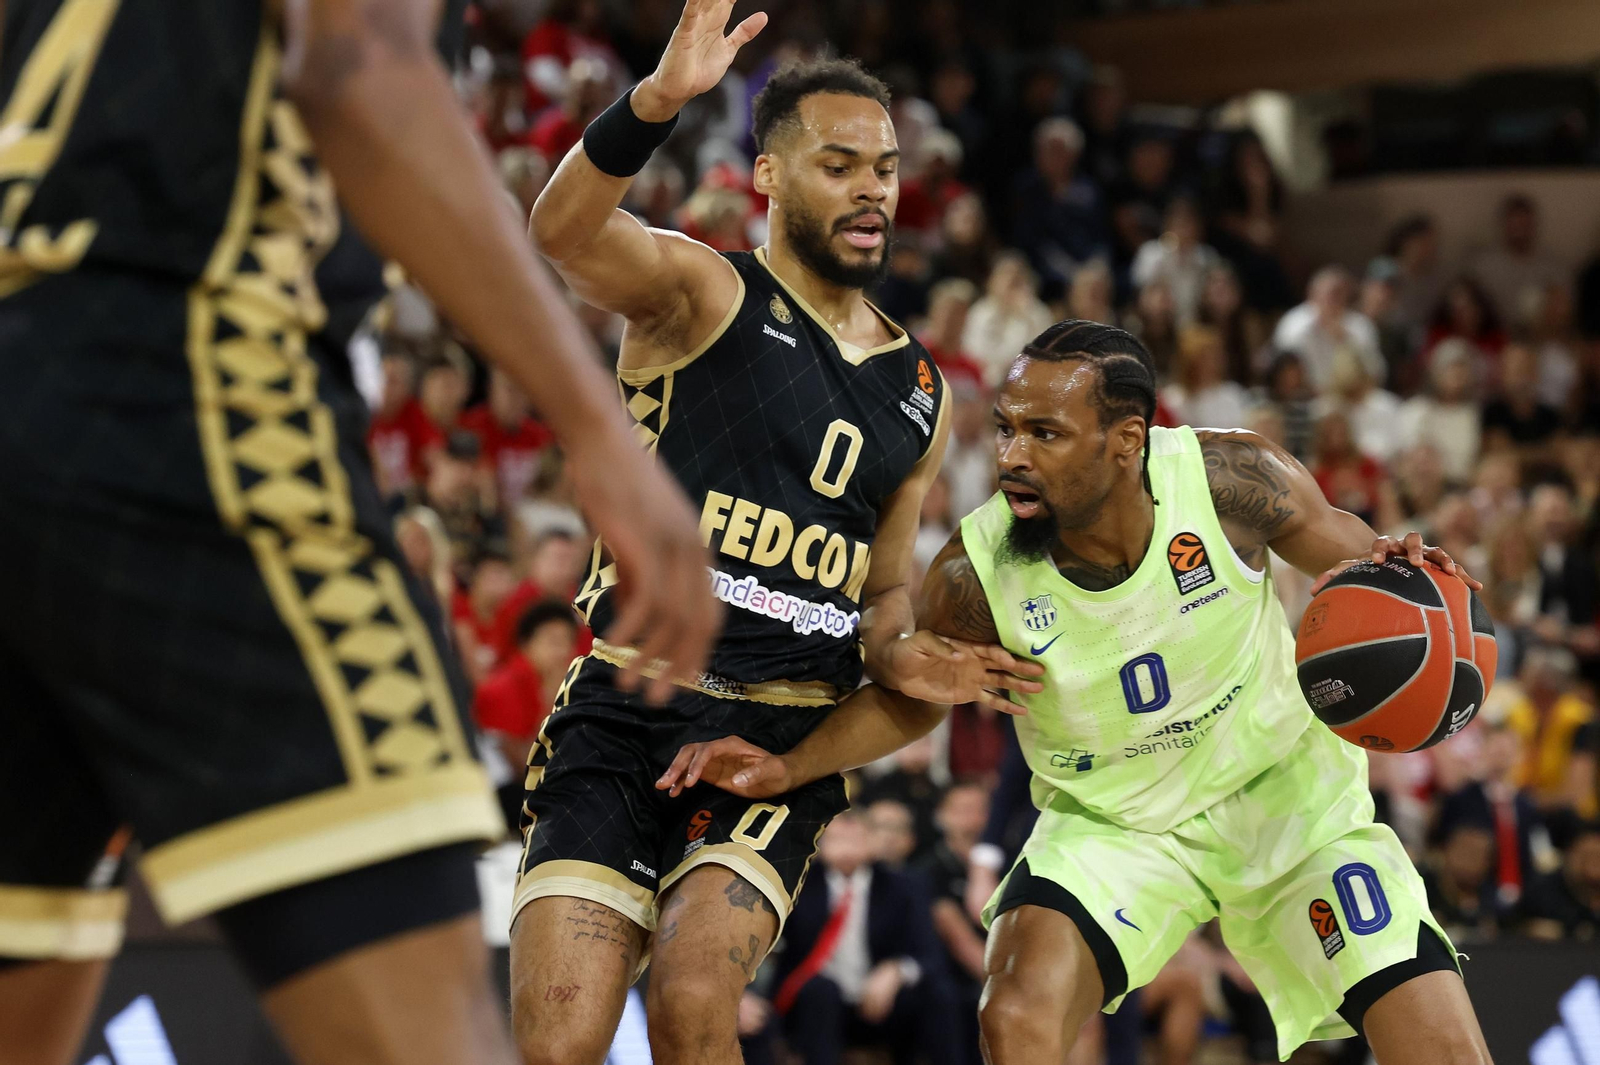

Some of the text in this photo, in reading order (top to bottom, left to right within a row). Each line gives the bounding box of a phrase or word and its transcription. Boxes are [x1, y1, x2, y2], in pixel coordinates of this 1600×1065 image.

[763, 324, 796, 348] SPALDING
[809, 419, 863, 499] 0
[1178, 565, 1209, 582] TURKISH
[1180, 571, 1211, 587] AIRLINES
[706, 570, 846, 632] ndacrypto
[1180, 588, 1228, 613] oneteam
[1119, 652, 1171, 714] 0
[730, 803, 790, 850] 0
[1332, 862, 1392, 935] 0
[544, 985, 581, 1002] 1997
